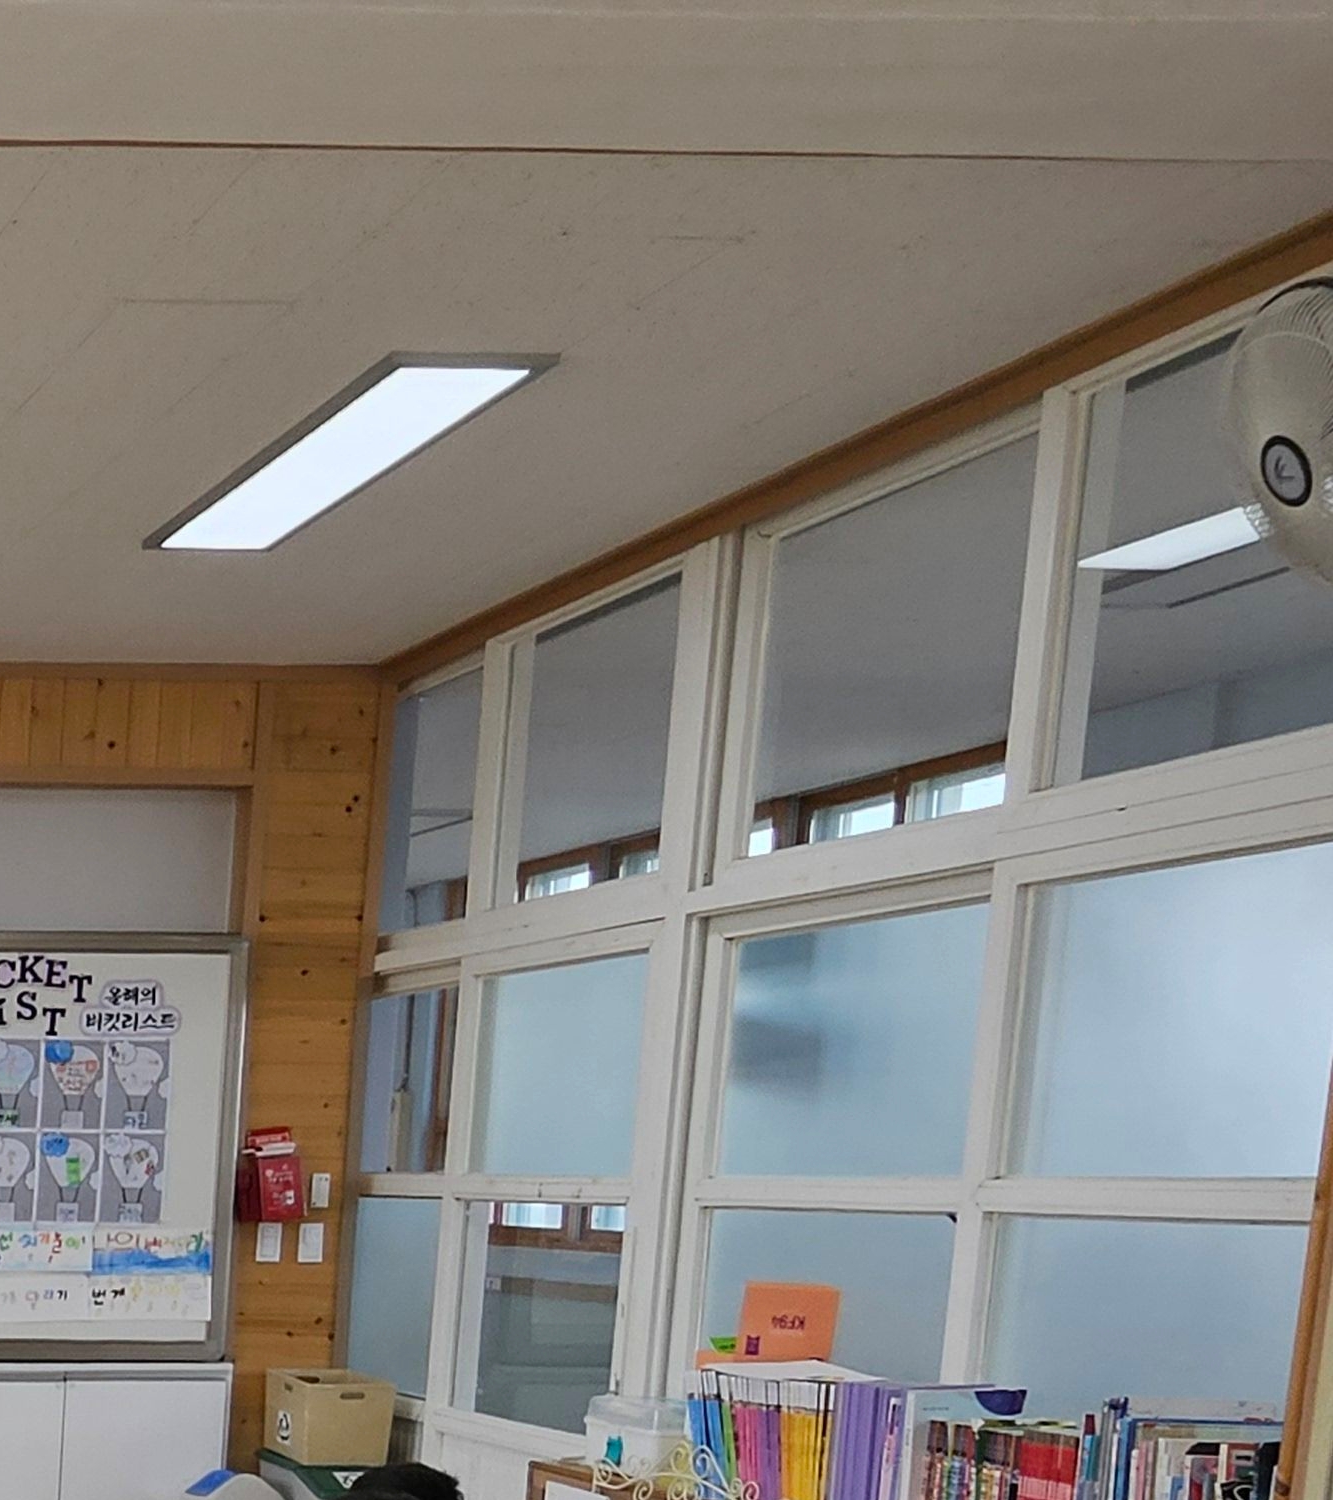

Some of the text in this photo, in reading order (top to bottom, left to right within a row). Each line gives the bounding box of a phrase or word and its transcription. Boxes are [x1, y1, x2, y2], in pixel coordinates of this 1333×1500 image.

[104, 985, 158, 1006] 올해의
[85, 1011, 179, 1032] 버킷리스트
[771, 1314, 806, 1331] KF94
